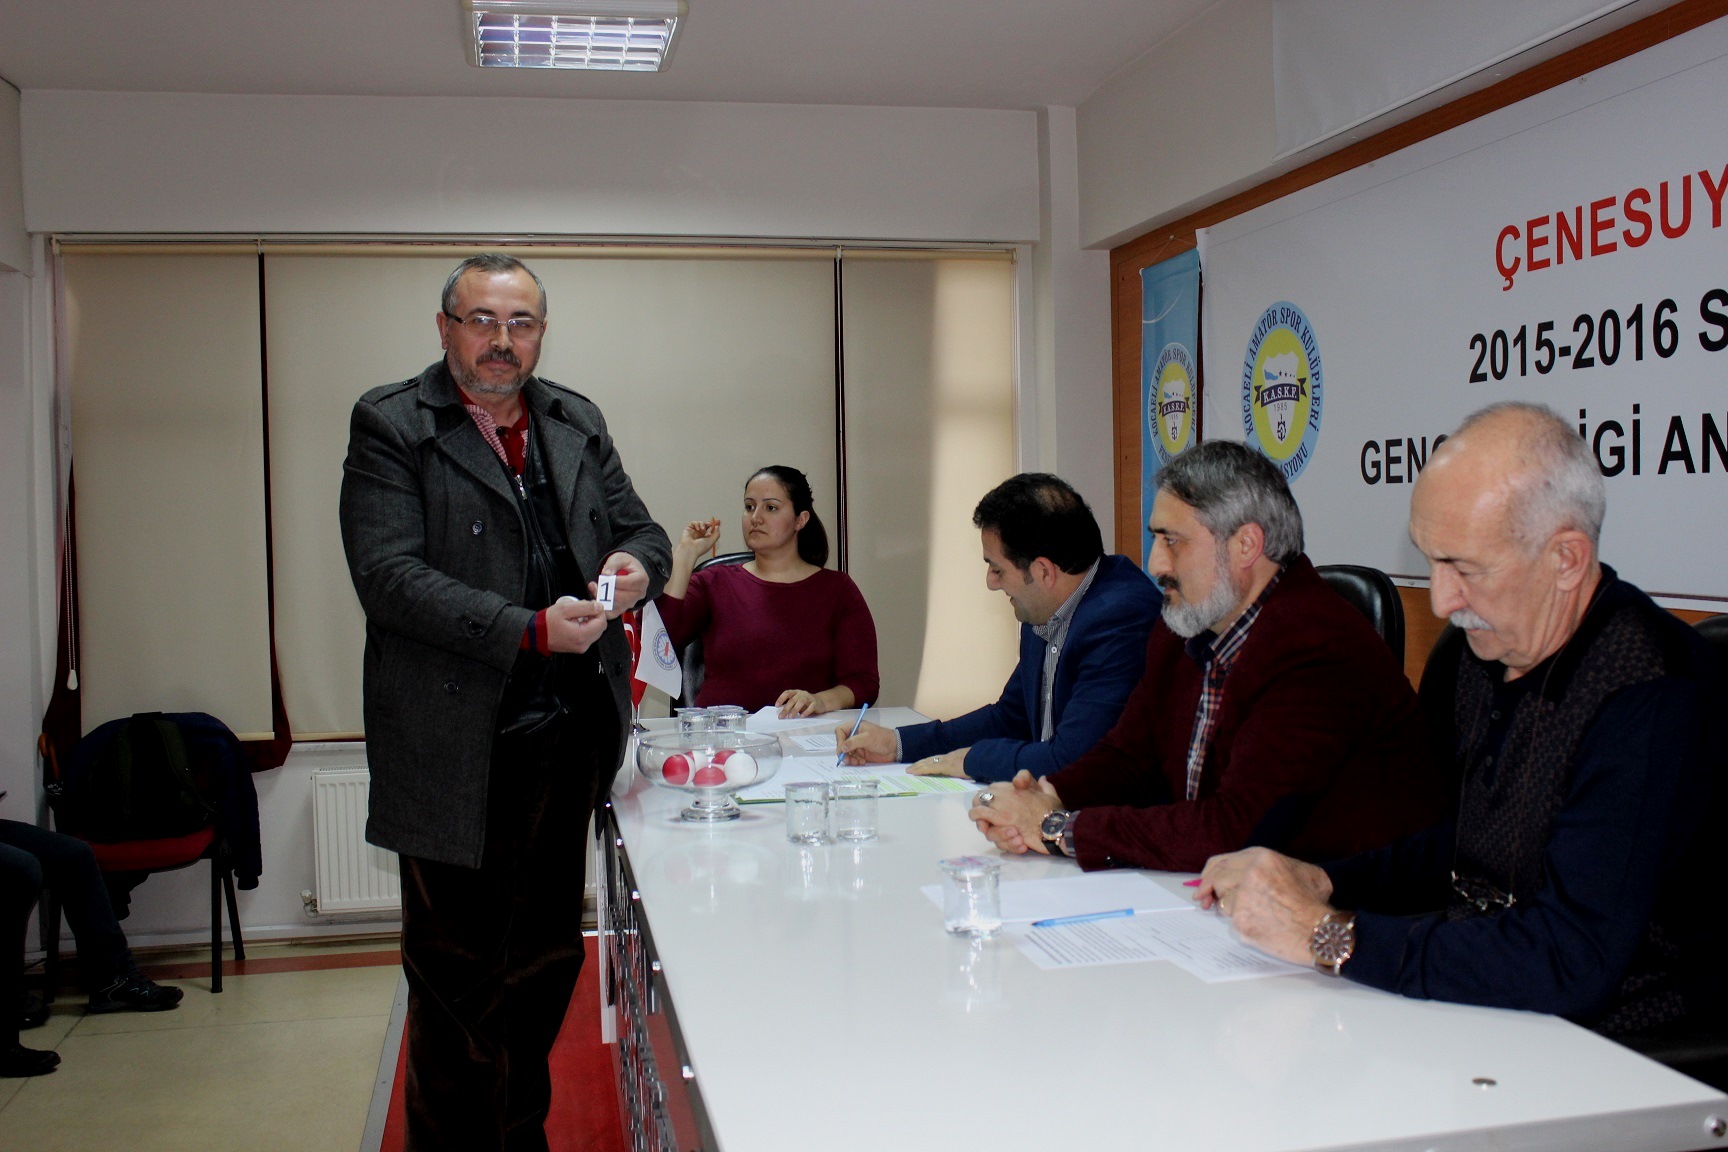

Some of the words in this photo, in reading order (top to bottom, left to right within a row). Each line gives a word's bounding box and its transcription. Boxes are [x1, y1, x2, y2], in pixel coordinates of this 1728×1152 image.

[1495, 162, 1728, 291] ÇENESUY
[1469, 298, 1679, 383] 2015-2016
[1698, 288, 1728, 352] S
[1243, 361, 1254, 438] KOCAELİ
[1249, 308, 1278, 361] AMATÖR
[1280, 307, 1302, 333] SPOR
[1300, 325, 1321, 432] KULÜPLERİ
[1273, 402, 1288, 412] 1985
[1361, 434, 1449, 485] GEN
[596, 582, 612, 602] 1
